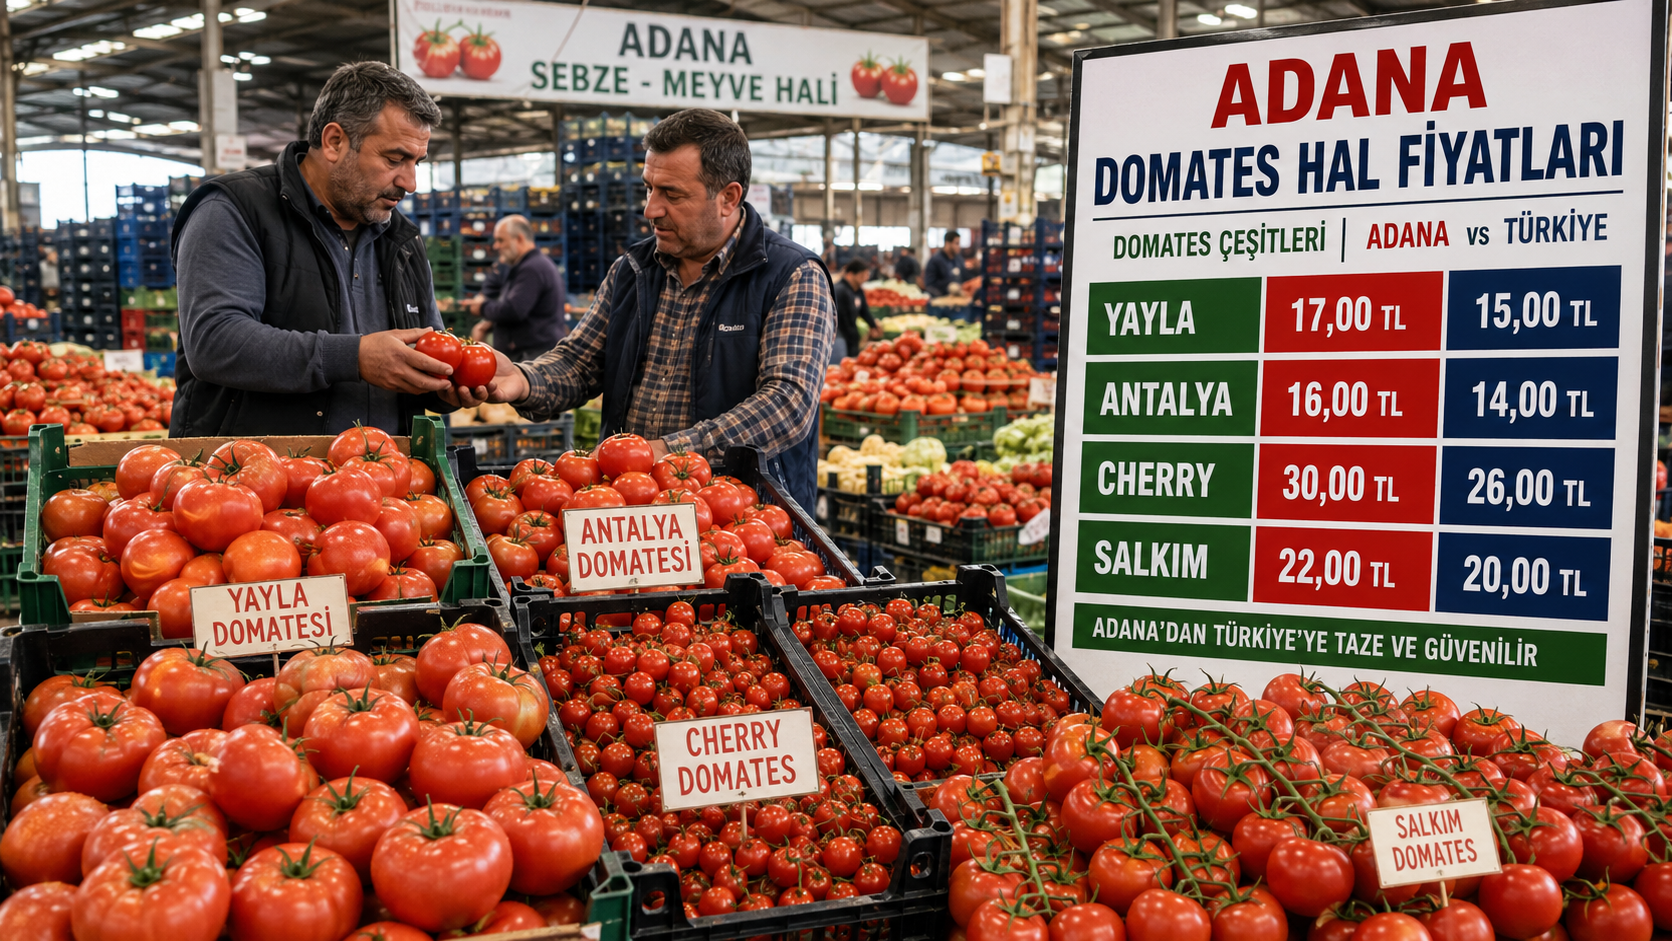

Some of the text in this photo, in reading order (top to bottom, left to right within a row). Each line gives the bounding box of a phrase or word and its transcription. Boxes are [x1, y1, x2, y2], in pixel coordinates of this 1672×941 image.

[619, 23, 752, 64] ADANA
[532, 61, 628, 94] SEBZE
[664, 70, 762, 101] MEYVE
[777, 73, 838, 105] HALİ
[1210, 41, 1487, 130] ADANA
[1094, 120, 1623, 205] DOMATES HAL FİYATLARI
[1114, 220, 1325, 262] DOMATES ÇEŞİTLERİ
[1367, 209, 1607, 249] ADANA vs TÜRKİYE
[1104, 301, 1195, 335] YAYLA
[1292, 296, 1406, 337] 17,00 TL
[1476, 291, 1597, 334] 15,00 TL
[1100, 382, 1232, 416] ANTALYA
[1288, 381, 1402, 422] 16,00 TL
[1473, 381, 1594, 423] 14,00 TL
[1098, 461, 1215, 497] CHERRY
[1283, 465, 1399, 506] 30,00 TL
[1468, 468, 1590, 511] 26,00 TL
[582, 514, 683, 547] ANTALYA
[578, 540, 691, 580] DOMATESİ
[1094, 540, 1207, 579] SALKIM
[1279, 548, 1395, 590] 22,00 TL
[1463, 555, 1586, 599] 20,00 TL
[227, 582, 308, 613] YAYLA
[213, 606, 333, 646] DOMATESİ
[1093, 617, 1537, 666] ADANA’DAN TÜRKİYE’YE TAZE VE GÜVENİLİR
[685, 719, 780, 757] CHERRY
[678, 753, 796, 796] DOMATES
[1395, 808, 1463, 839] SALKIM
[1392, 838, 1477, 871] DOMATES
